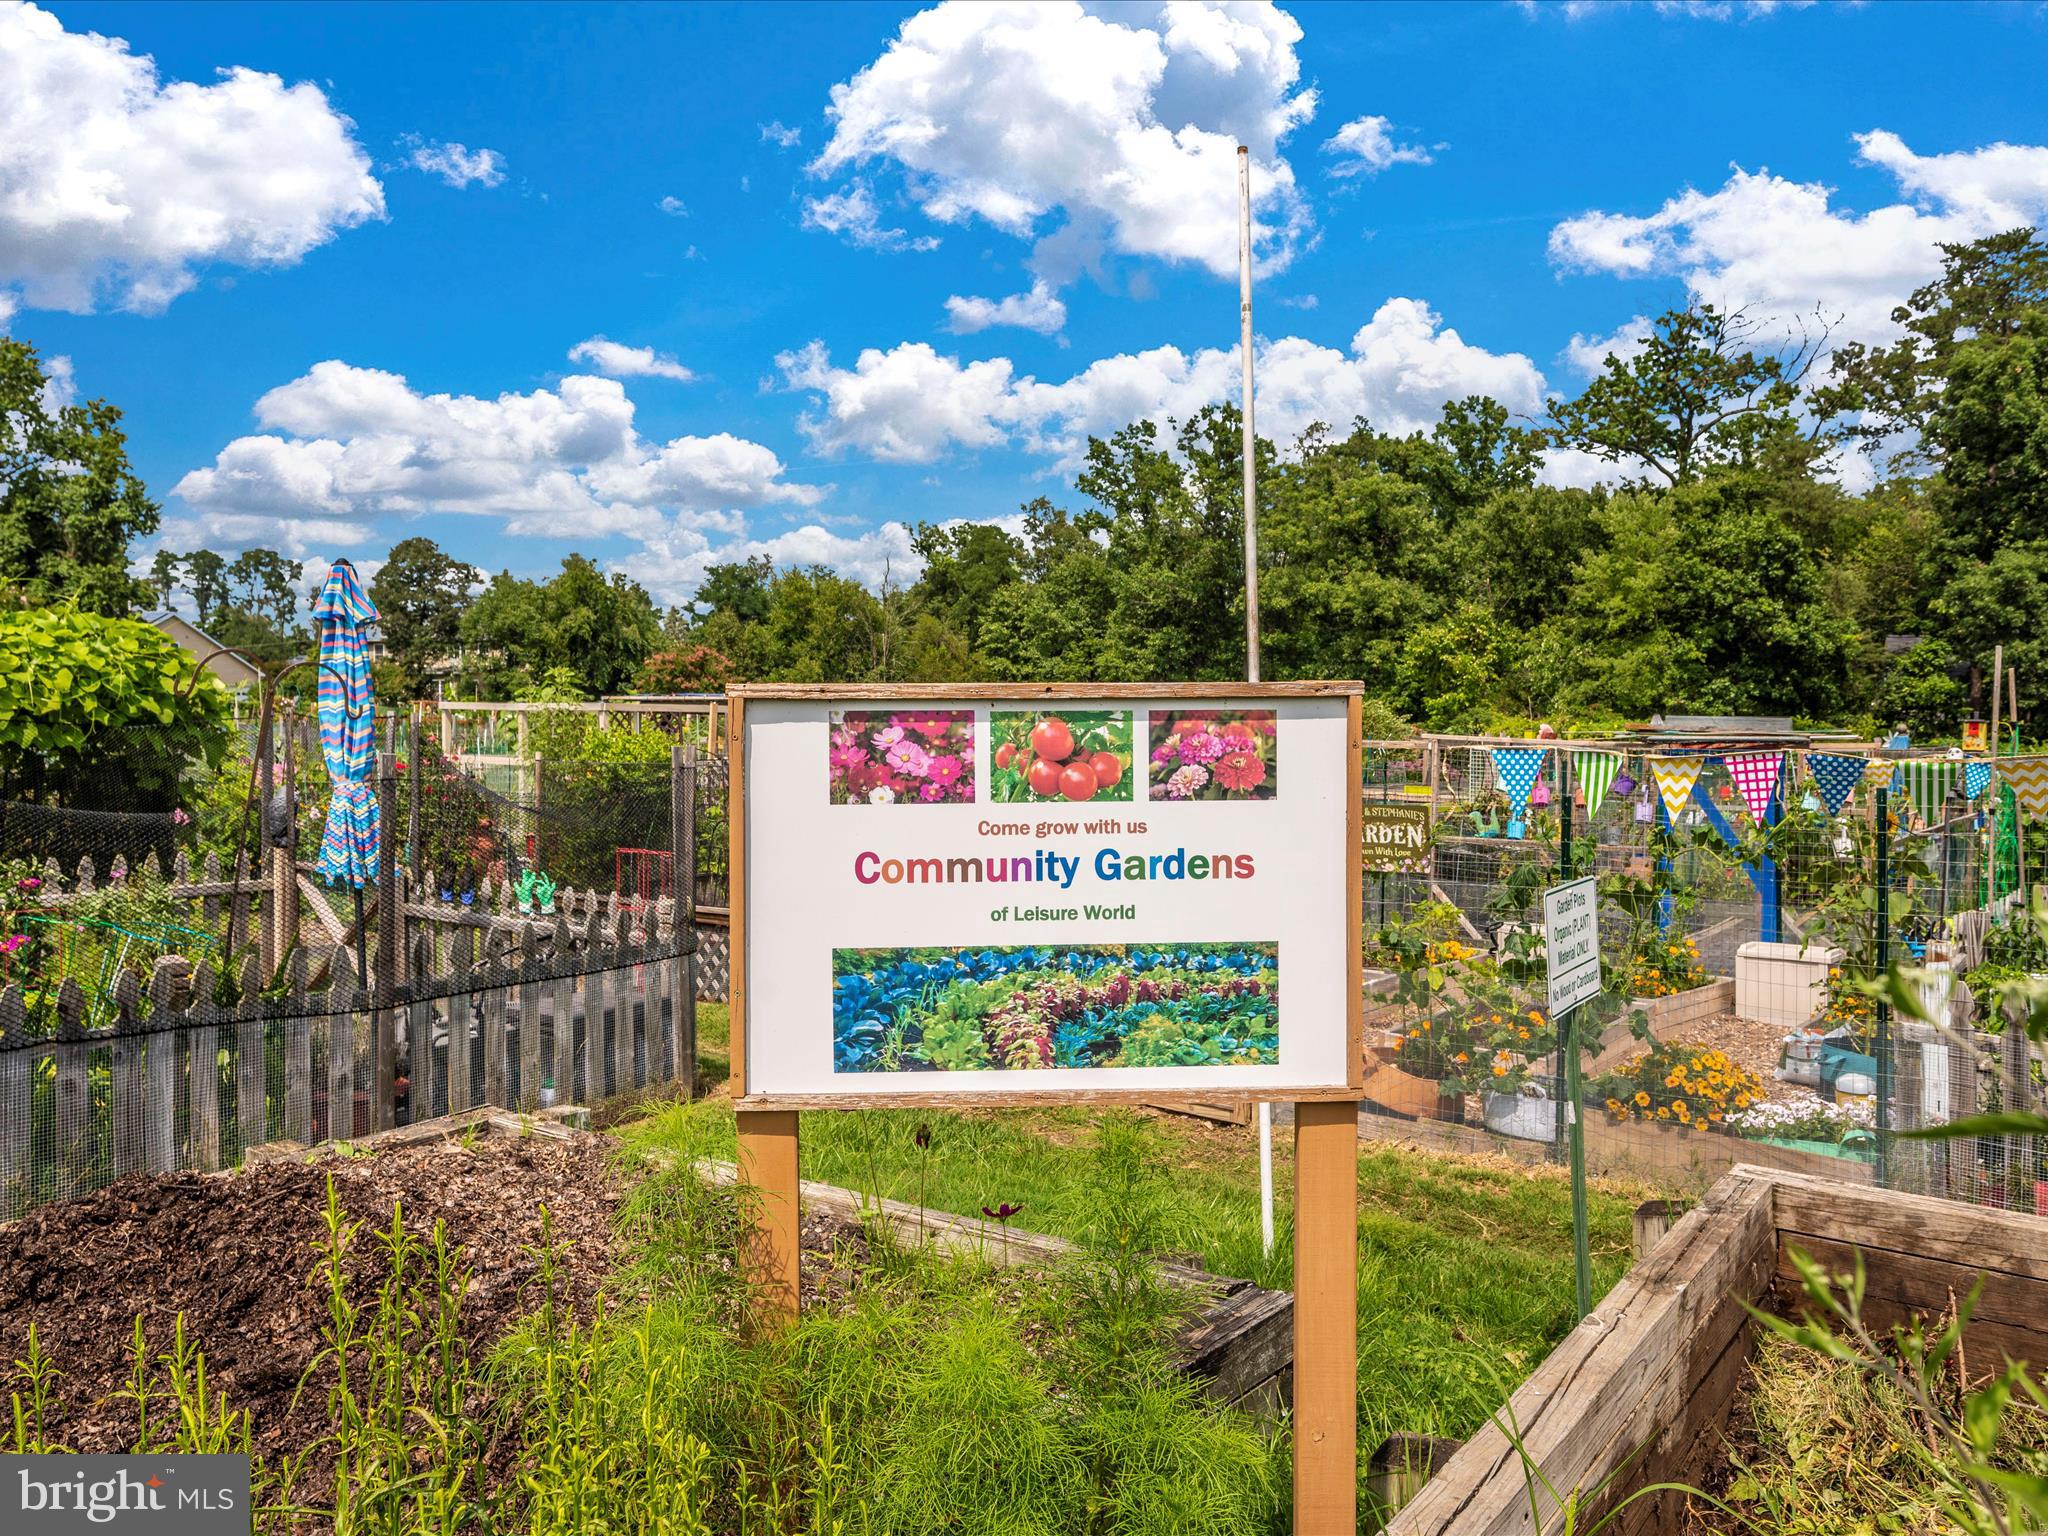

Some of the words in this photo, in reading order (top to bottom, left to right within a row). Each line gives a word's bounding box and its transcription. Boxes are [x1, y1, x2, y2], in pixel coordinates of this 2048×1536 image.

[977, 820, 1031, 836] Come
[1035, 821, 1079, 838] grow
[1083, 818, 1121, 834] with
[1127, 821, 1148, 834] us
[1362, 823, 1423, 848] RDEN
[1375, 846, 1394, 856] With
[1395, 847, 1412, 857] Love
[854, 849, 1080, 889] Community
[1094, 847, 1255, 882] Gardens
[990, 906, 1009, 922] of
[1014, 906, 1079, 922] Leisure
[1083, 904, 1136, 921] World
[1556, 896, 1573, 915] Garden
[1573, 893, 1586, 908] Plots
[1553, 922, 1572, 944] Organic
[1572, 913, 1591, 938] (PLANT)
[1557, 943, 1576, 967] Material
[1576, 938, 1590, 957] ONLY
[1552, 988, 1560, 1003] No
[1559, 981, 1572, 999] Wood
[1577, 965, 1598, 989] Cardboard
